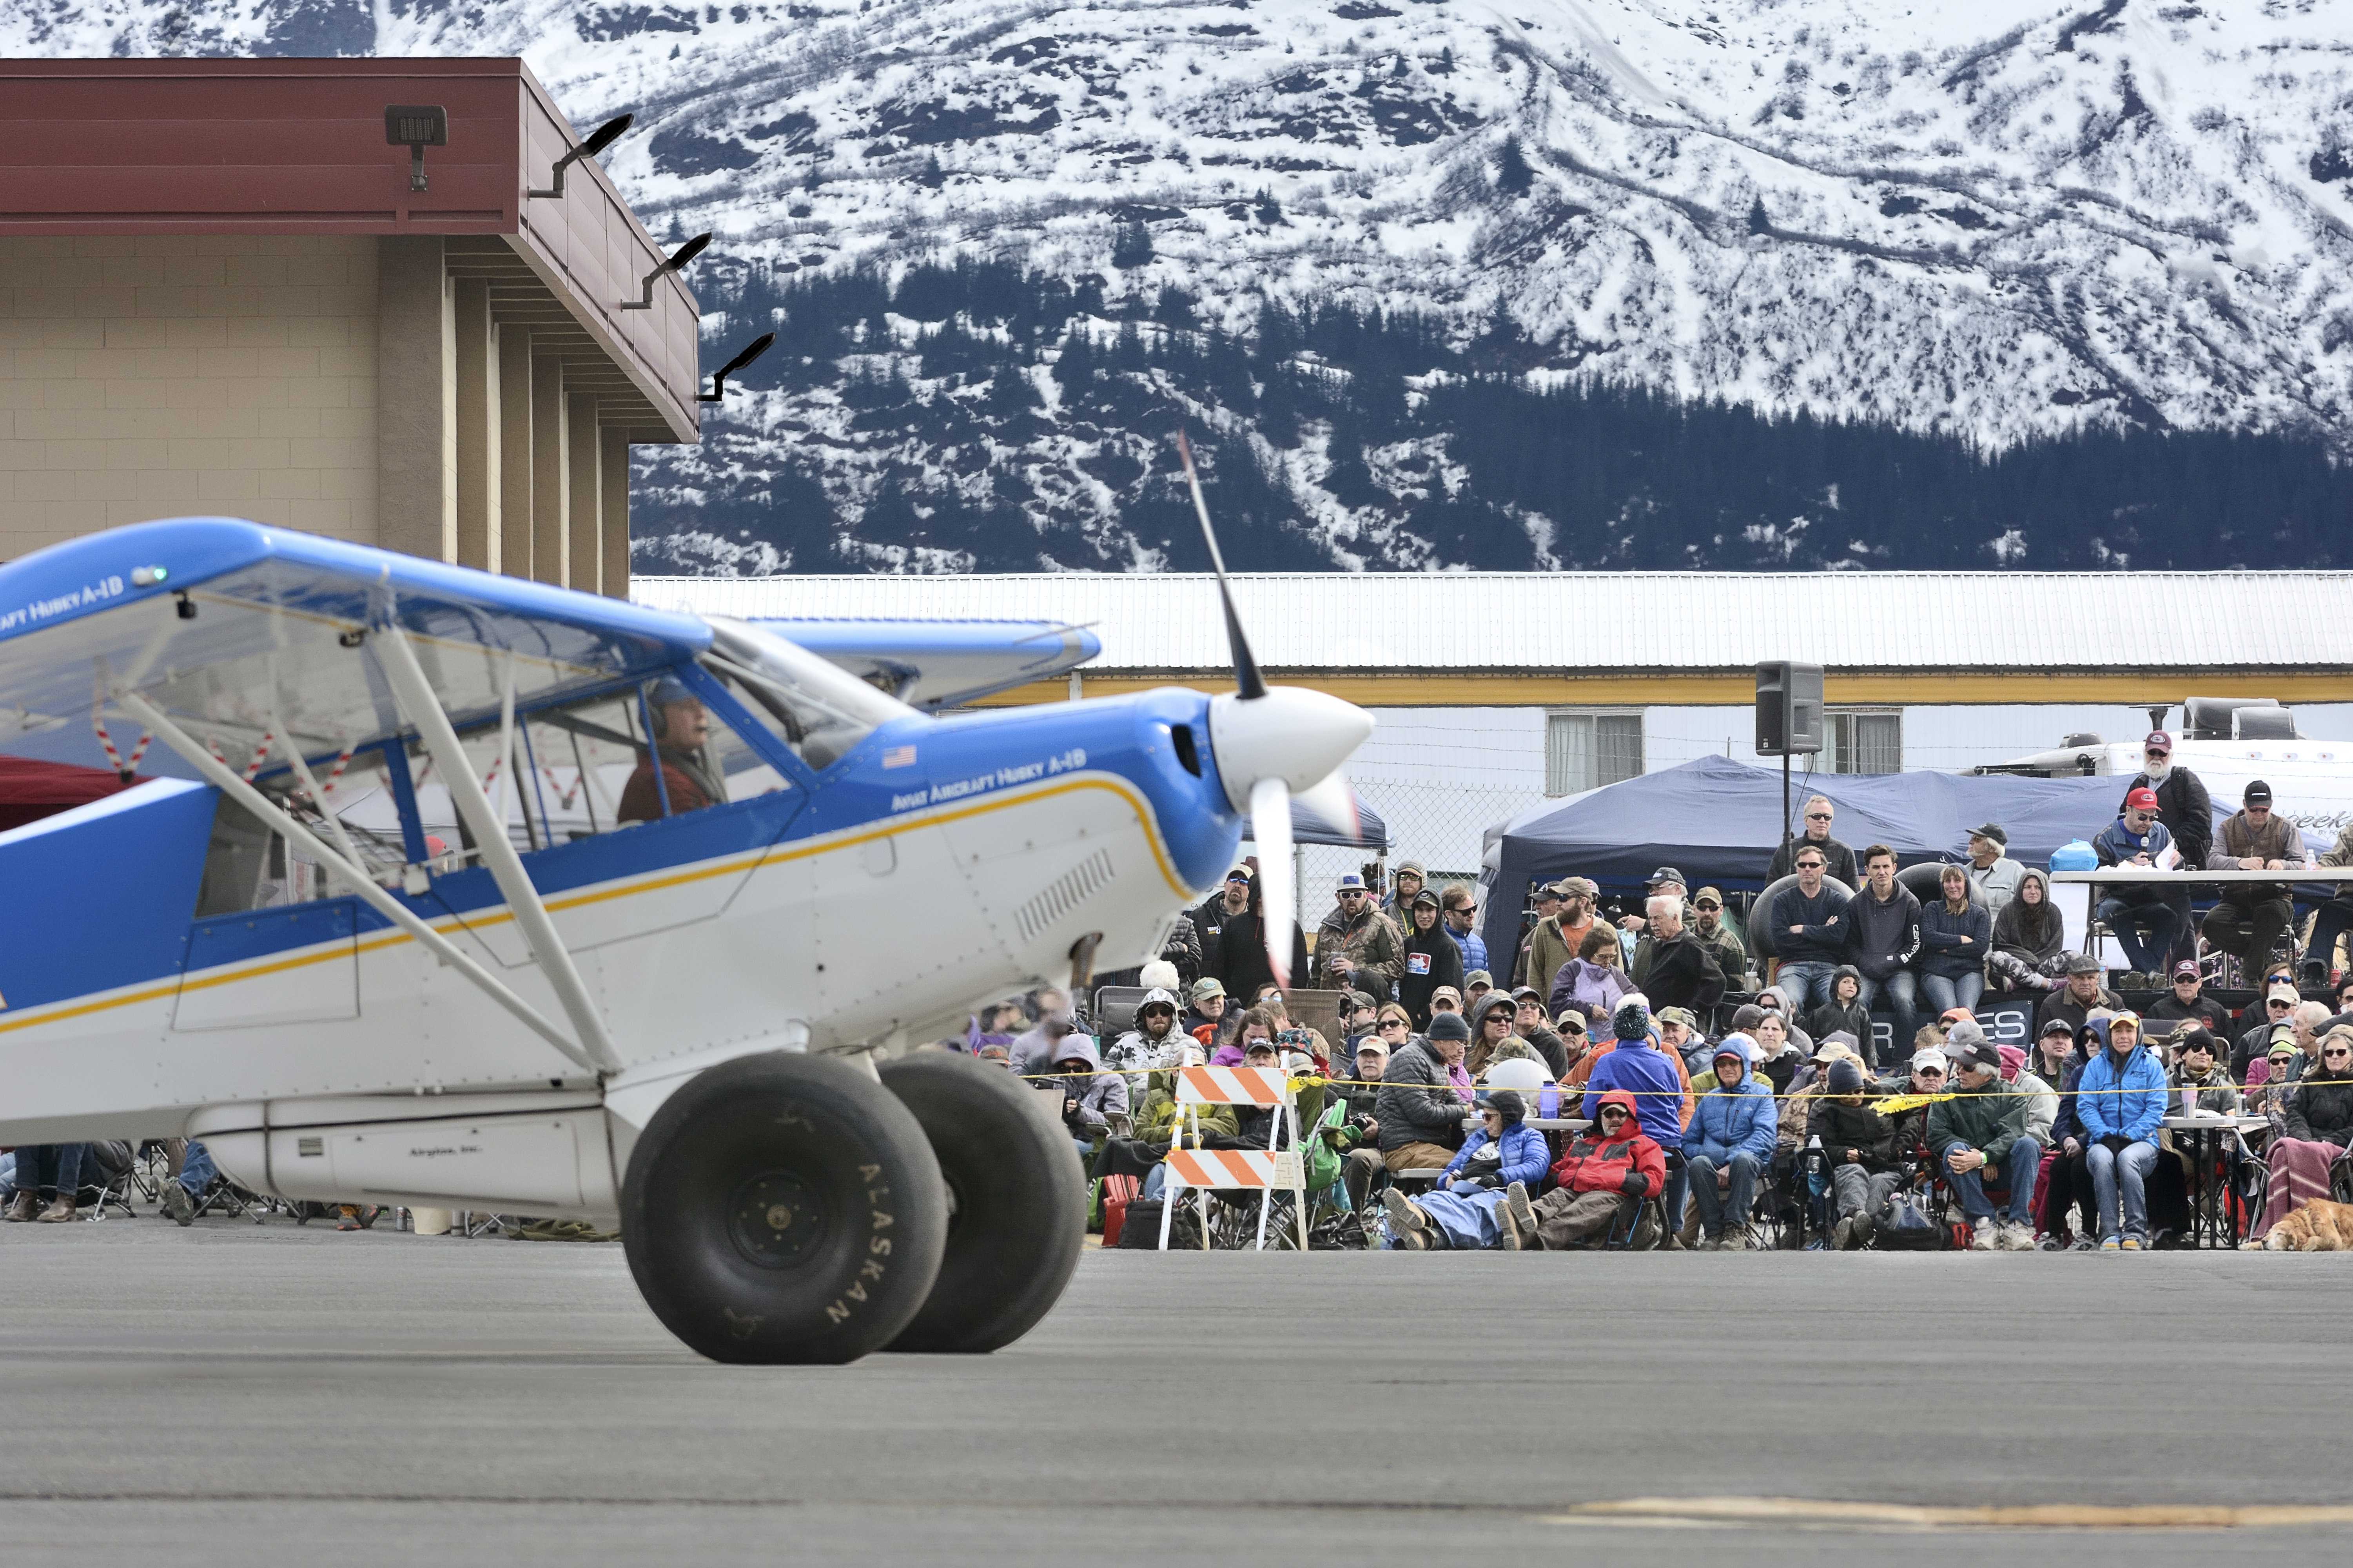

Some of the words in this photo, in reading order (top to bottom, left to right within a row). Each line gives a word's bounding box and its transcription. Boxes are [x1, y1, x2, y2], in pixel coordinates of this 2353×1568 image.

[930, 774, 995, 802] AIRCRAFT
[997, 762, 1043, 786] HUSKY
[826, 1164, 894, 1324] ALASKAN
